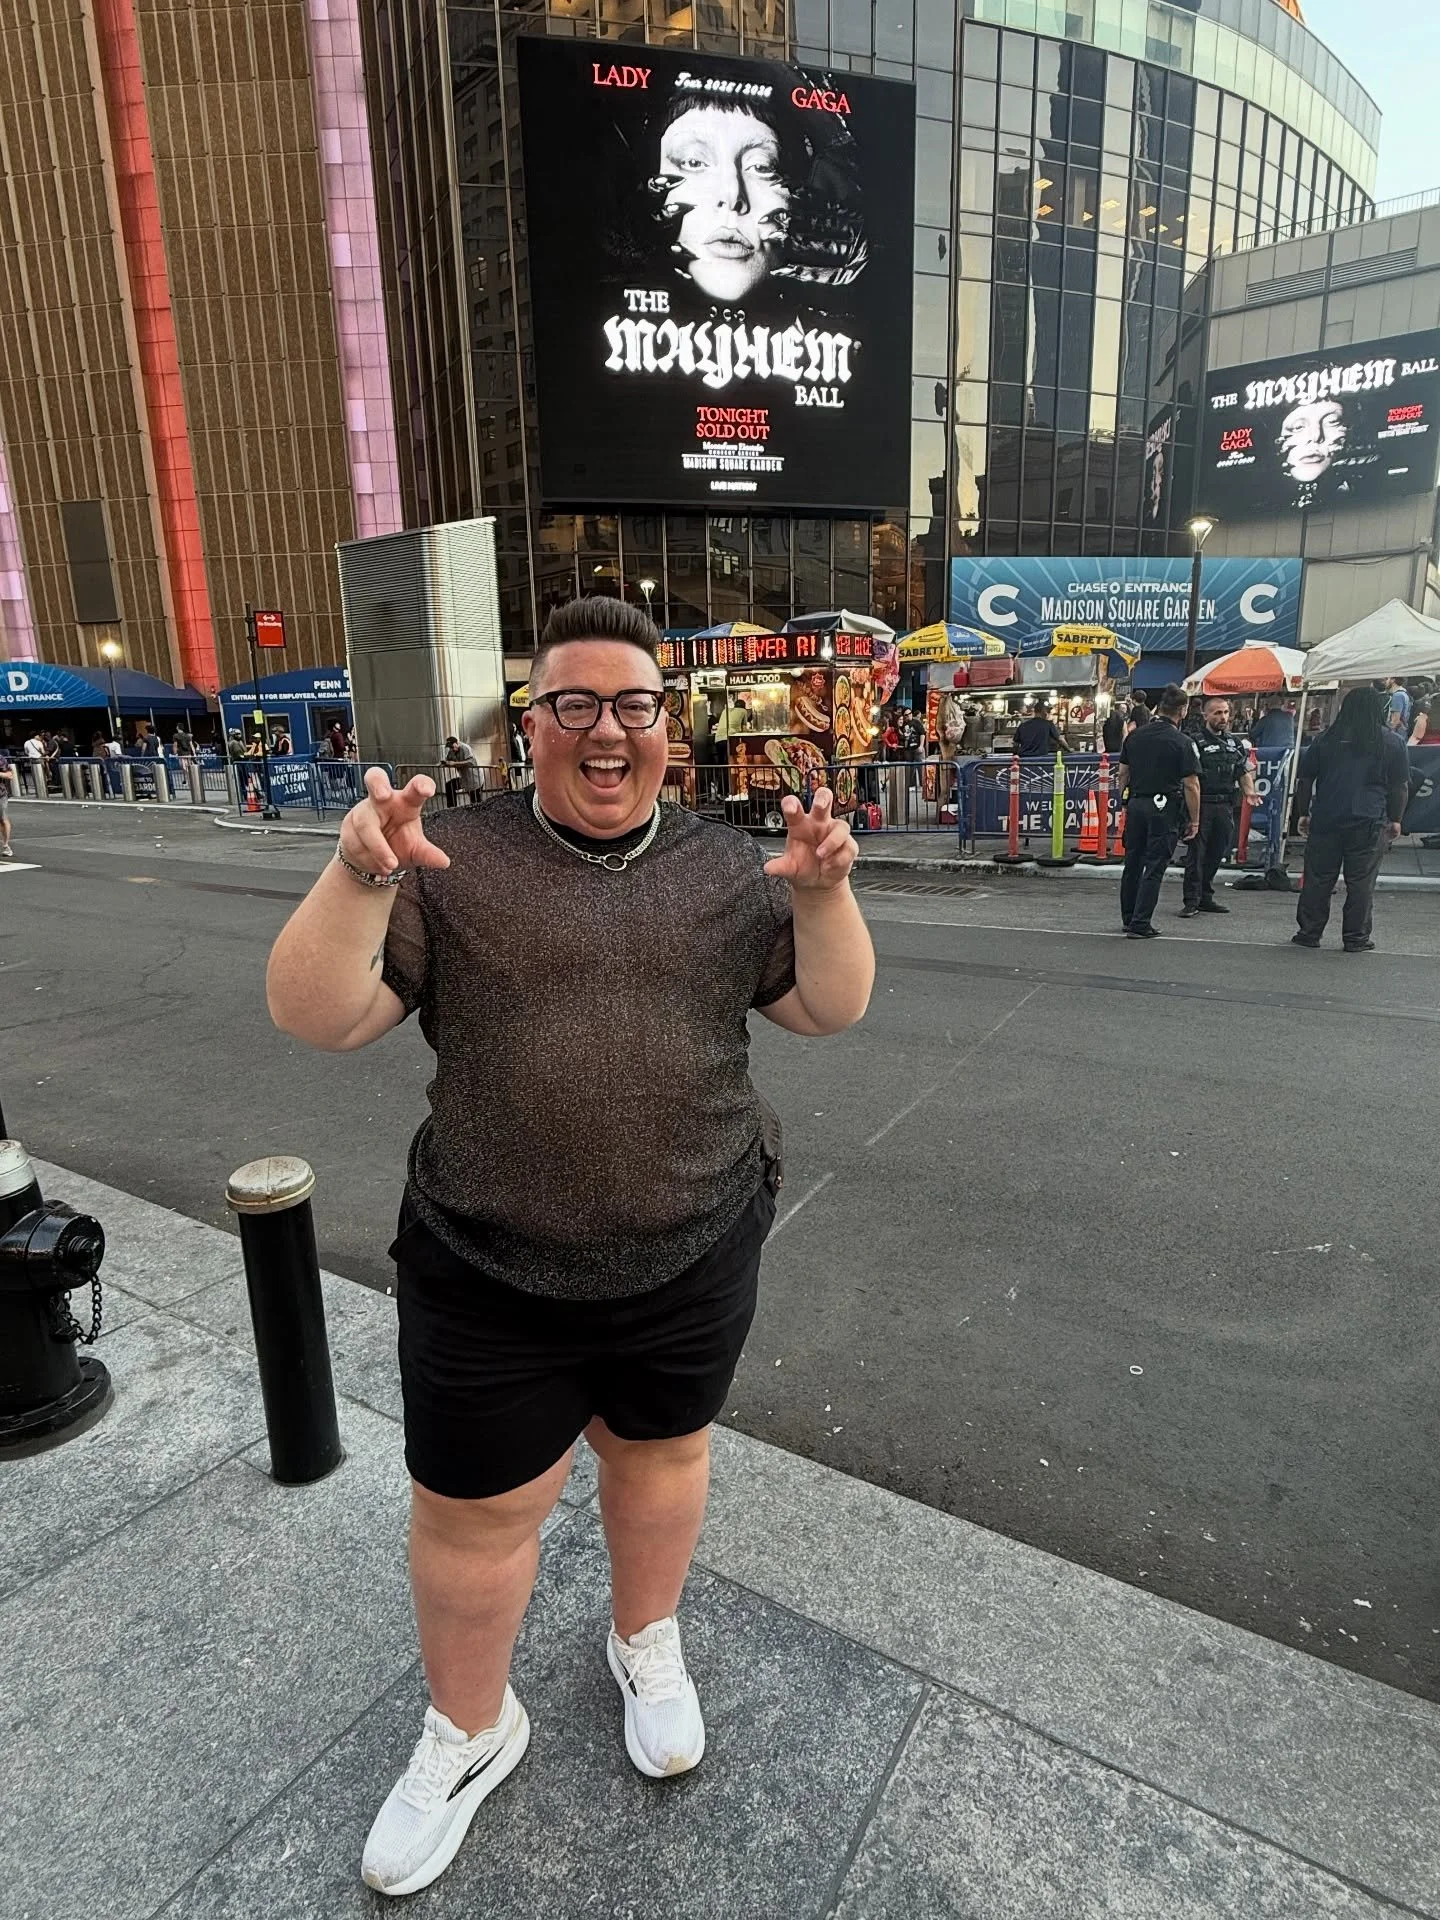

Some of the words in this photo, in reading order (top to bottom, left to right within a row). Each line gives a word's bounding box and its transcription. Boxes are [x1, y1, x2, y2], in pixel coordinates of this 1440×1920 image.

[592, 63, 651, 89] LADY
[674, 71, 703, 89] Tour
[791, 87, 851, 114] GAGA
[624, 289, 670, 313] THE
[1401, 358, 1439, 377] BALL
[794, 385, 844, 408] BALL
[1211, 393, 1238, 409] THE
[696, 406, 769, 424] TONIGHT
[696, 423, 736, 438] SOLD
[737, 424, 770, 440] OUT
[1223, 427, 1253, 441] LADY
[1220, 438, 1253, 450] GAGA
[1068, 583, 1108, 593] CHASE
[1125, 583, 1193, 593] ENTRANCE
[977, 584, 1020, 626] C
[1041, 597, 1104, 621] MADISON
[1108, 596, 1160, 622] SQUARE
[1240, 583, 1279, 625] C
[1056, 633, 1112, 645] SABRETT
[898, 646, 945, 658] SABRETT
[8, 671, 29, 692] D
[313, 680, 342, 690] PENN
[729, 675, 756, 685] HALAL
[757, 673, 781, 683] FOOD
[15, 693, 64, 702] ENTRANCE
[231, 693, 264, 701] ENTRANE
[278, 692, 317, 700] EMPLOYEES,
